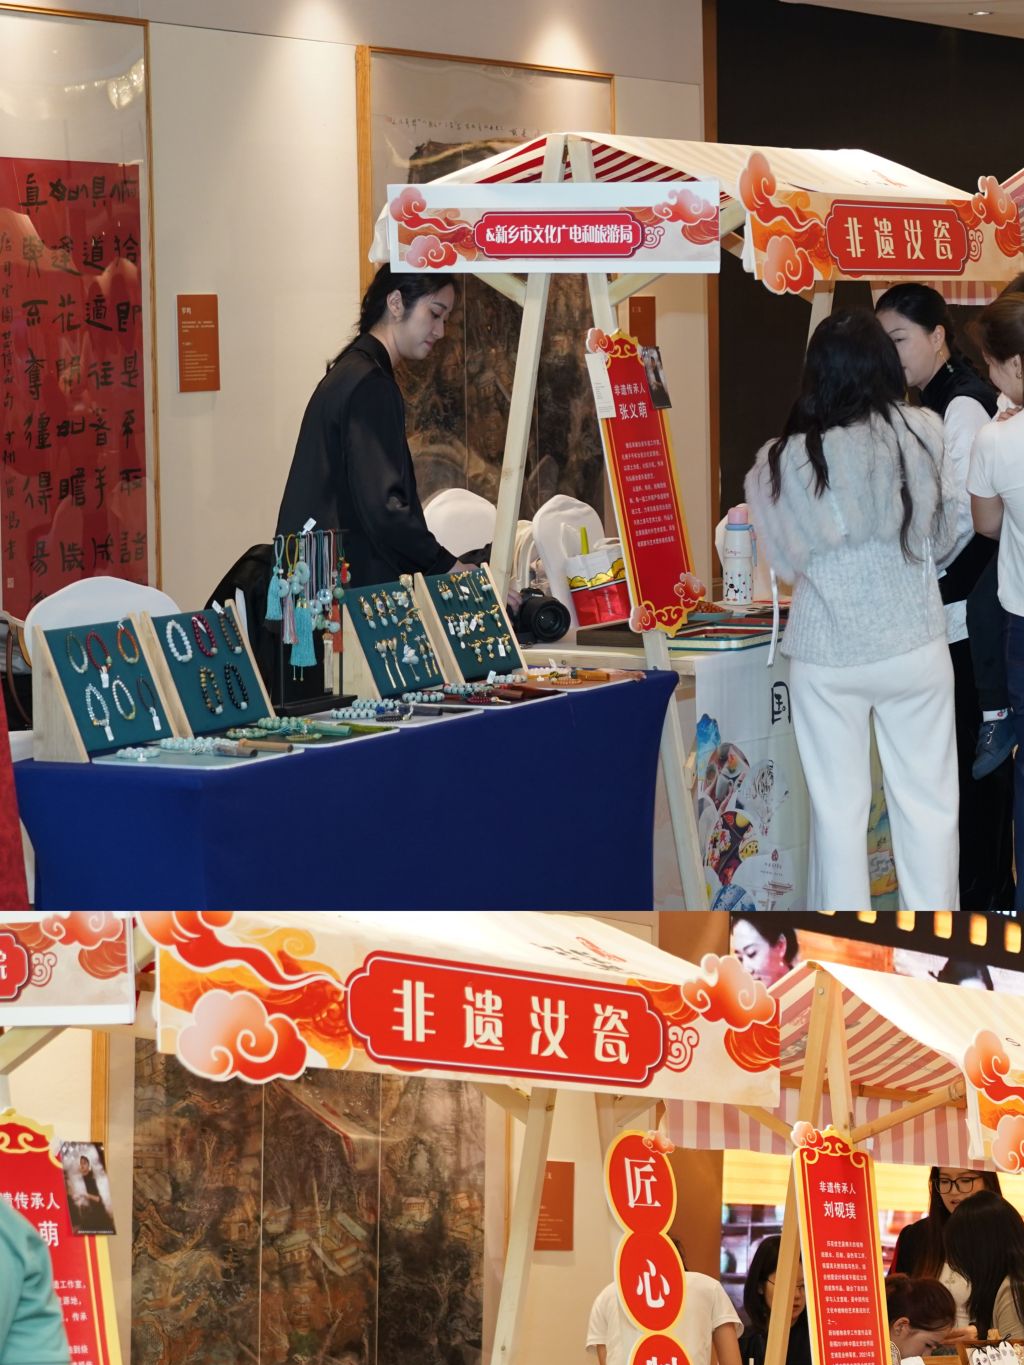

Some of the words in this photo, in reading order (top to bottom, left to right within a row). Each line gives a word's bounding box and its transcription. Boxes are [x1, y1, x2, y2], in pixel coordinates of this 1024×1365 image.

[485, 224, 633, 244] &新乡市文化广电和旅游局
[844, 216, 953, 260] 非遗汝瓷
[392, 978, 630, 1066] 非遗汝瓷
[819, 1181, 857, 1196] 非遗传承人
